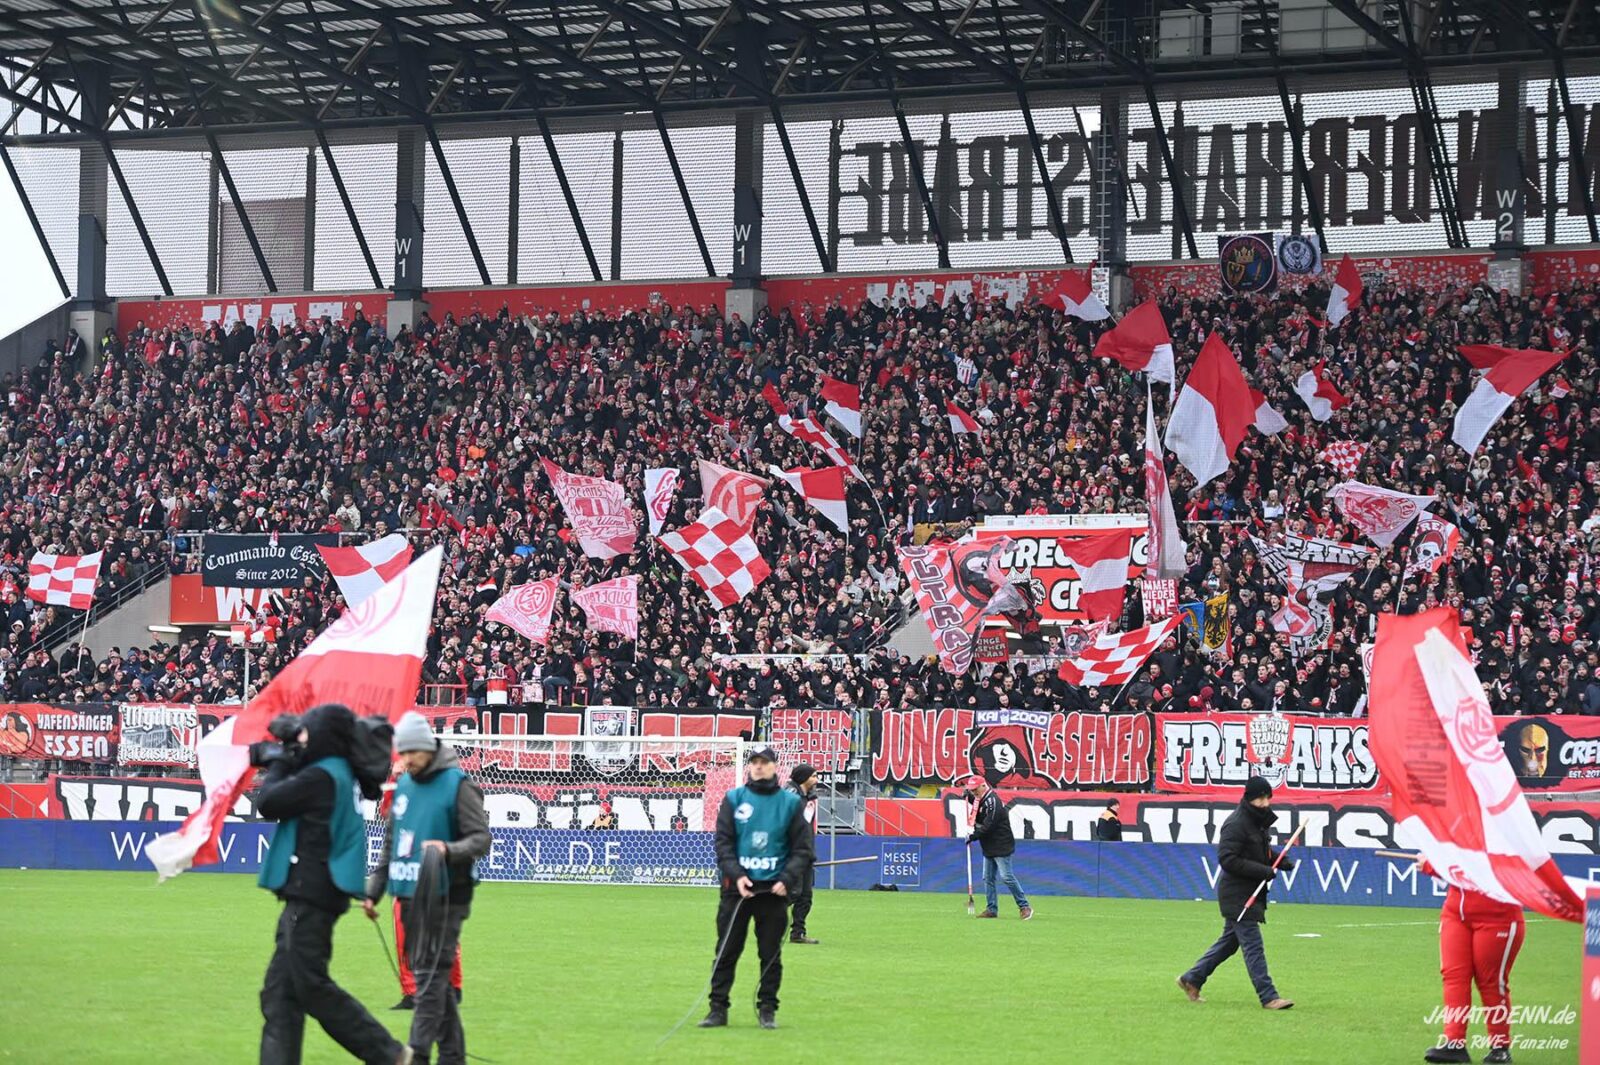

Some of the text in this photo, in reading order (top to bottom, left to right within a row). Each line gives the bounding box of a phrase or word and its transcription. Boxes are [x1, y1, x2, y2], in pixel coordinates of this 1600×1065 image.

[1496, 189, 1517, 208] W
[734, 223, 752, 242] W
[1498, 212, 1514, 234] 2
[395, 238, 412, 255] W
[737, 245, 746, 265] 1
[398, 258, 406, 278] 1
[206, 542, 286, 570] Commando
[236, 568, 298, 580] Since 2012
[37, 711, 114, 731] HAFENSÄNGER
[771, 708, 852, 731] SEKTION
[977, 711, 1049, 726] KAI 2000
[44, 734, 109, 758] ESSEN
[871, 709, 975, 781] JUNGE
[1033, 711, 1152, 784] ESSENER
[1559, 740, 1600, 765] CRE
[1163, 721, 1379, 790] FREAKS
[883, 851, 919, 864] MESSE
[633, 866, 717, 878] GARTENBAU
[883, 864, 919, 877] ESSEN
